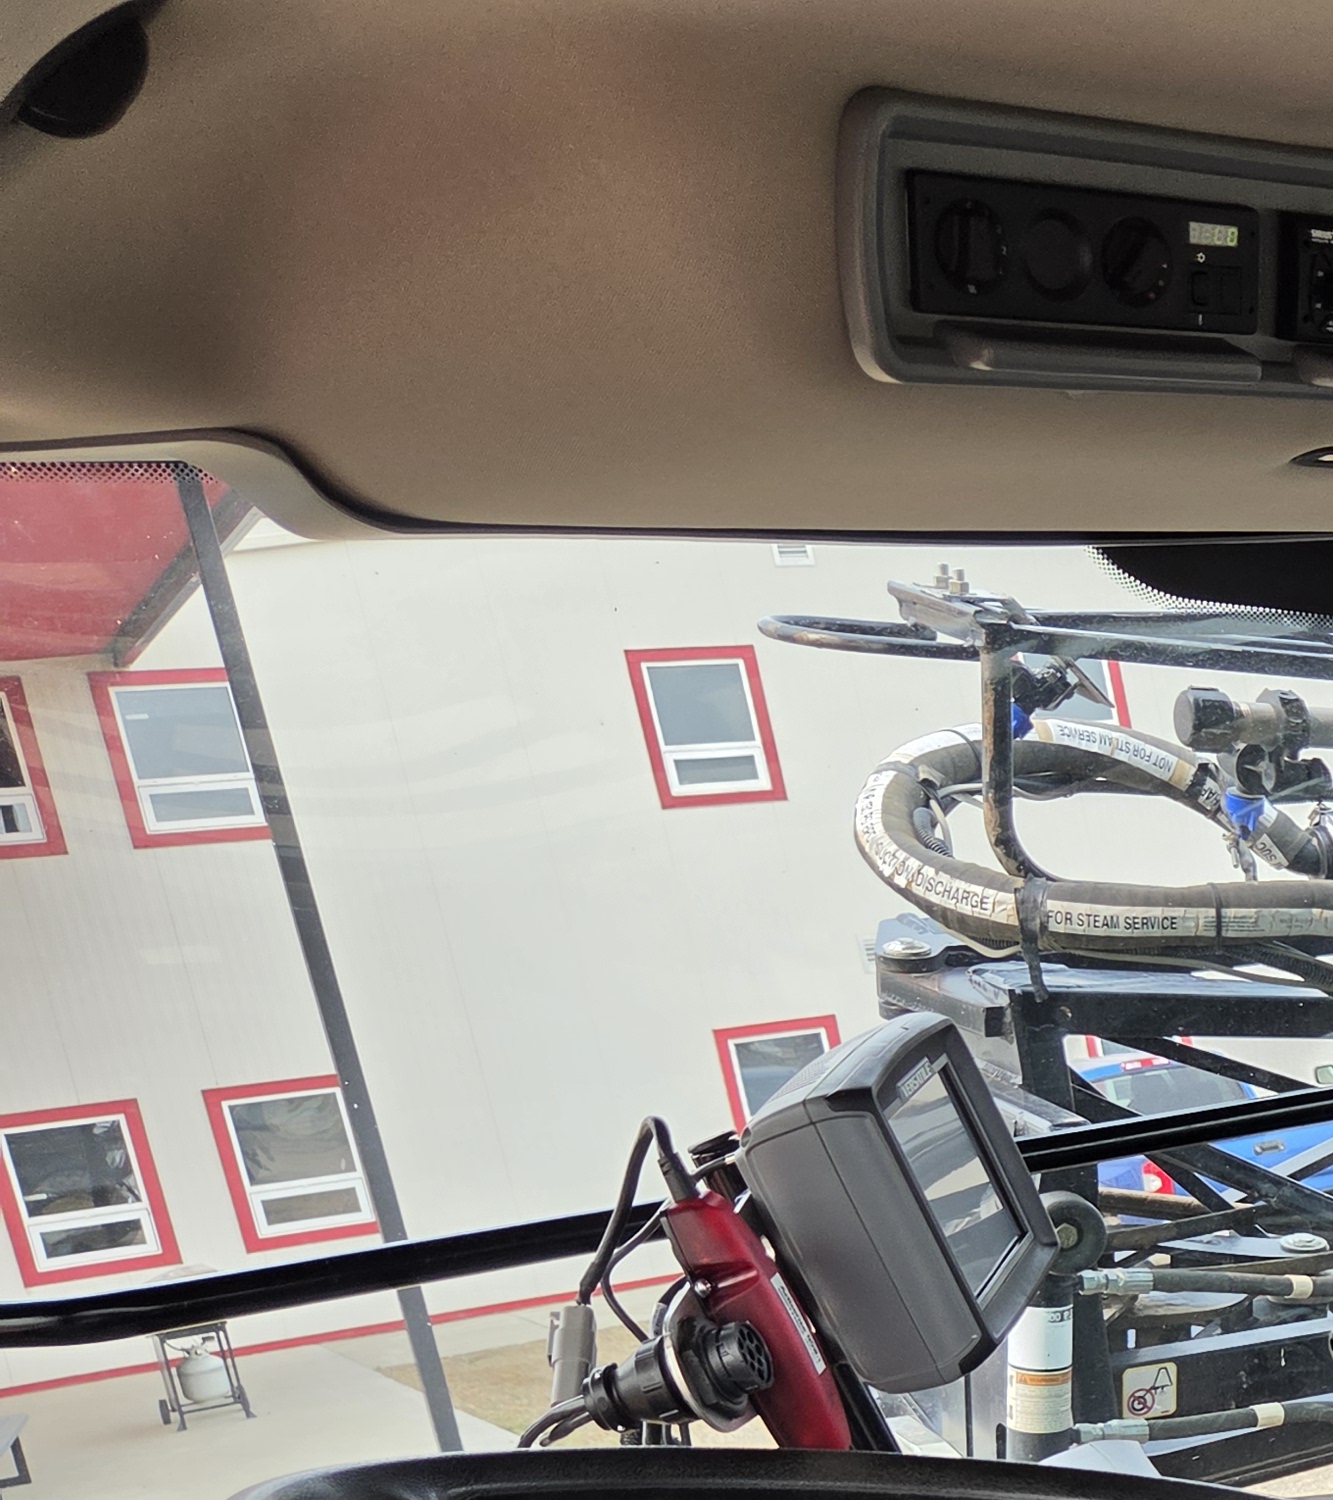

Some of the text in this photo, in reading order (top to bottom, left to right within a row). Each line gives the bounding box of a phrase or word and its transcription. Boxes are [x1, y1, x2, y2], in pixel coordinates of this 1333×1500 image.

[1056, 723, 1097, 745] SERVICE
[1132, 743, 1152, 763] FOR
[1151, 755, 1174, 774] NOT
[1047, 909, 1178, 931] FOR STEAM SERVICE
